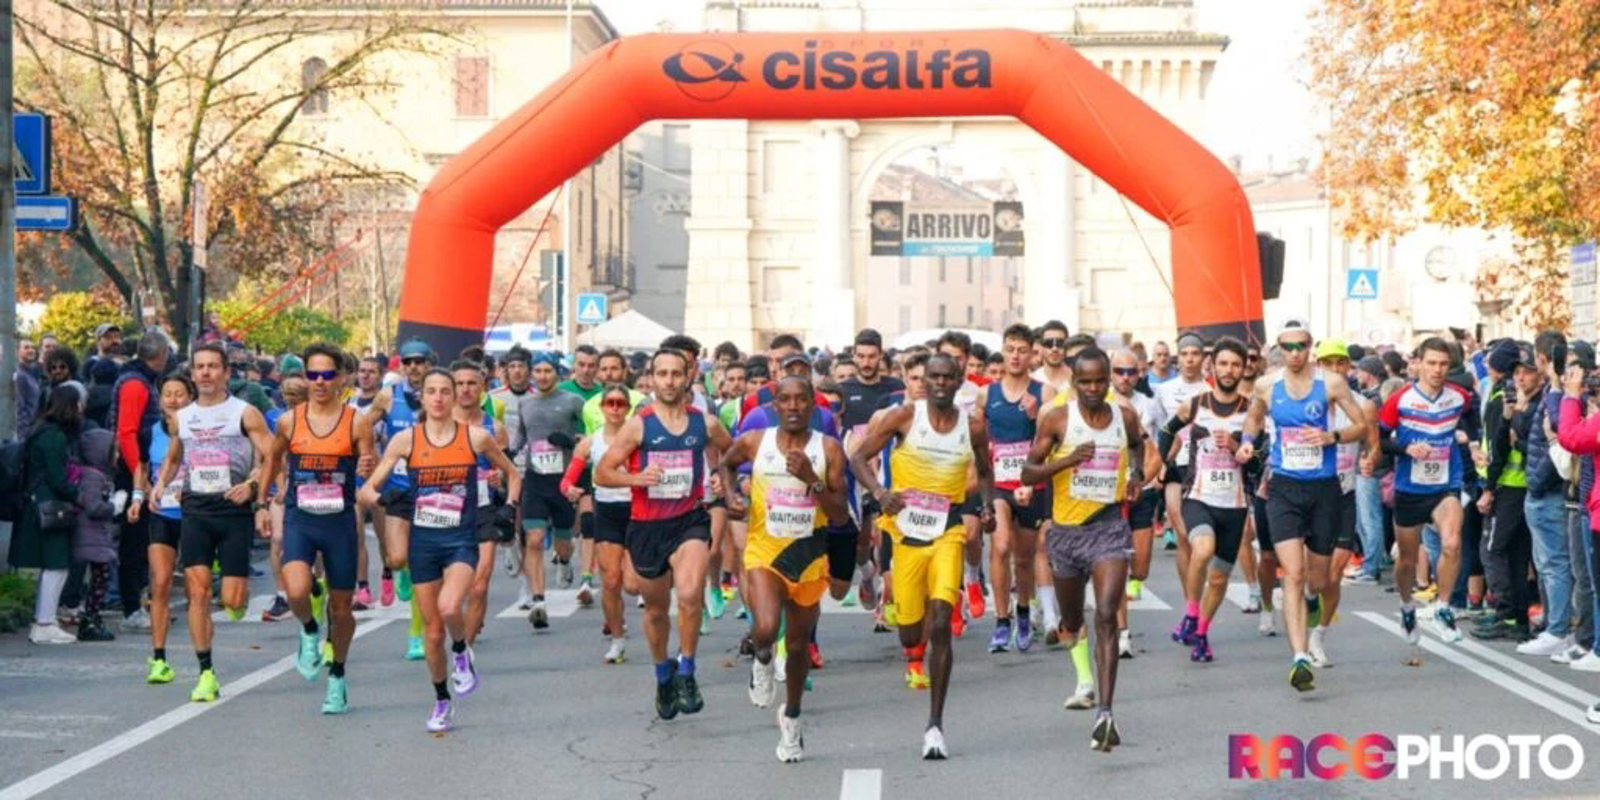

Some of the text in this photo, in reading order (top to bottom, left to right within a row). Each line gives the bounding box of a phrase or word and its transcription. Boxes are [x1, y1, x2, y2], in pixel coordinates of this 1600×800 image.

[821, 38, 952, 49] SPORT
[762, 40, 992, 91] cisalfa
[907, 213, 990, 238] ARRIVO
[539, 453, 558, 464] 117
[1424, 462, 1440, 474] 59
[418, 466, 467, 486] FREEZONE
[1072, 475, 1118, 489] CHERUIYOT
[1210, 471, 1234, 482] 841
[768, 511, 812, 524] WAITHIRA
[908, 511, 938, 526] NJERI
